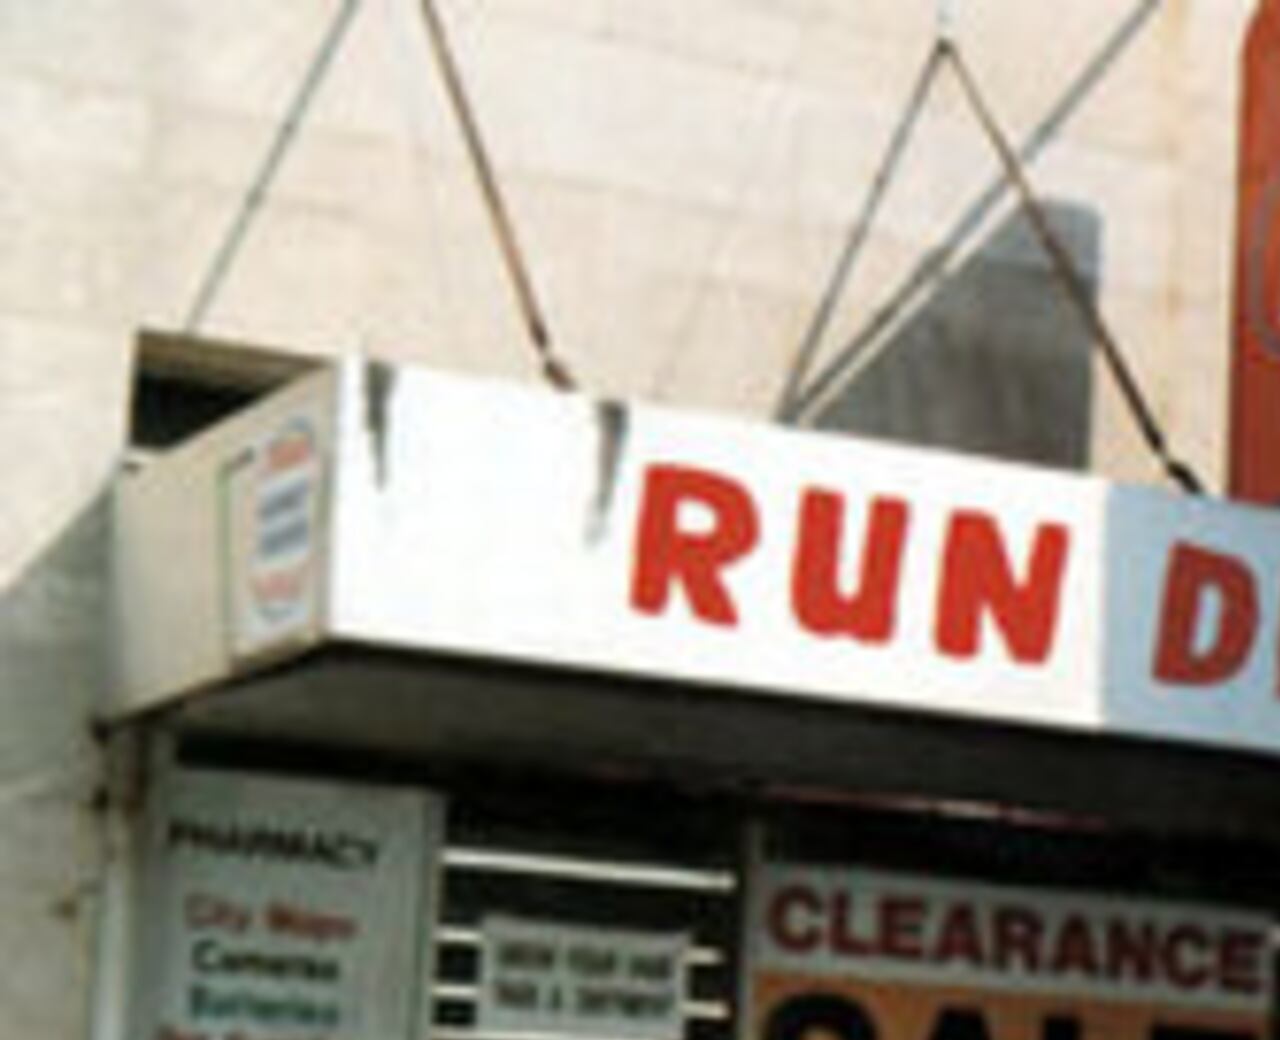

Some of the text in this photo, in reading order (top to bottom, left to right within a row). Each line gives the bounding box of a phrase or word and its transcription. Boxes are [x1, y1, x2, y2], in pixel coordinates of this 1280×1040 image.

[626, 460, 1071, 665] RUN
[165, 819, 379, 870] PHARMACY
[193, 940, 339, 982] Cameras
[766, 886, 1269, 995] CLEARANCE
